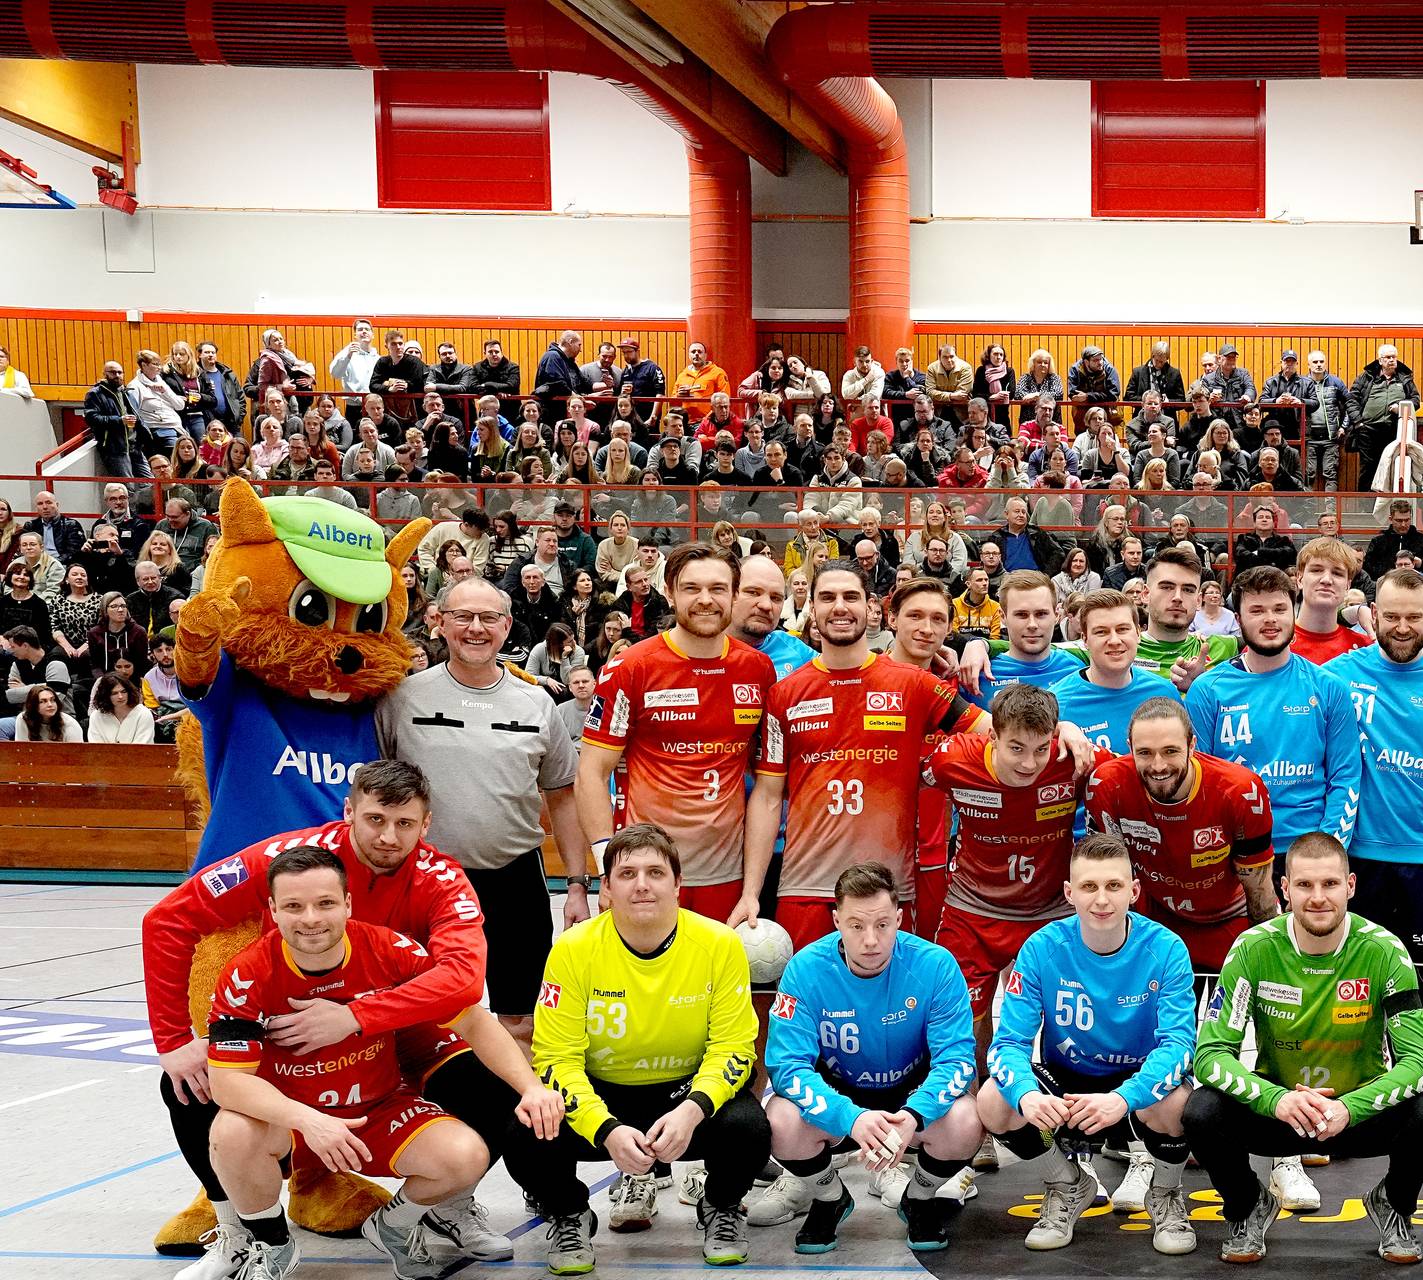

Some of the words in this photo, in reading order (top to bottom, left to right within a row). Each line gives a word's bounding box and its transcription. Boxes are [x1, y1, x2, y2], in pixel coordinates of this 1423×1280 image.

[307, 520, 373, 550] Albert
[990, 676, 1020, 687] hummel
[1350, 680, 1378, 692] hummel
[650, 711, 697, 722] Allbau
[1221, 703, 1249, 713] hummel
[1350, 692, 1377, 724] 31
[789, 720, 830, 734] Allbau
[1220, 712, 1253, 746] 44
[662, 740, 748, 756] westenerg
[801, 745, 899, 764] westenergie
[1259, 760, 1315, 777] Allbau
[703, 769, 721, 801] 3
[826, 779, 864, 816] 33
[958, 806, 999, 819] Allbau
[1007, 854, 1036, 884] 15
[1310, 967, 1336, 976] hummel
[592, 987, 626, 998] hummel
[587, 999, 628, 1040] 53
[822, 1008, 856, 1019] hummel
[1055, 989, 1095, 1032] 56
[1257, 1002, 1297, 1021] Allbau
[819, 1020, 860, 1054] 66
[633, 1056, 700, 1071] Allba
[1299, 1066, 1332, 1089] 12
